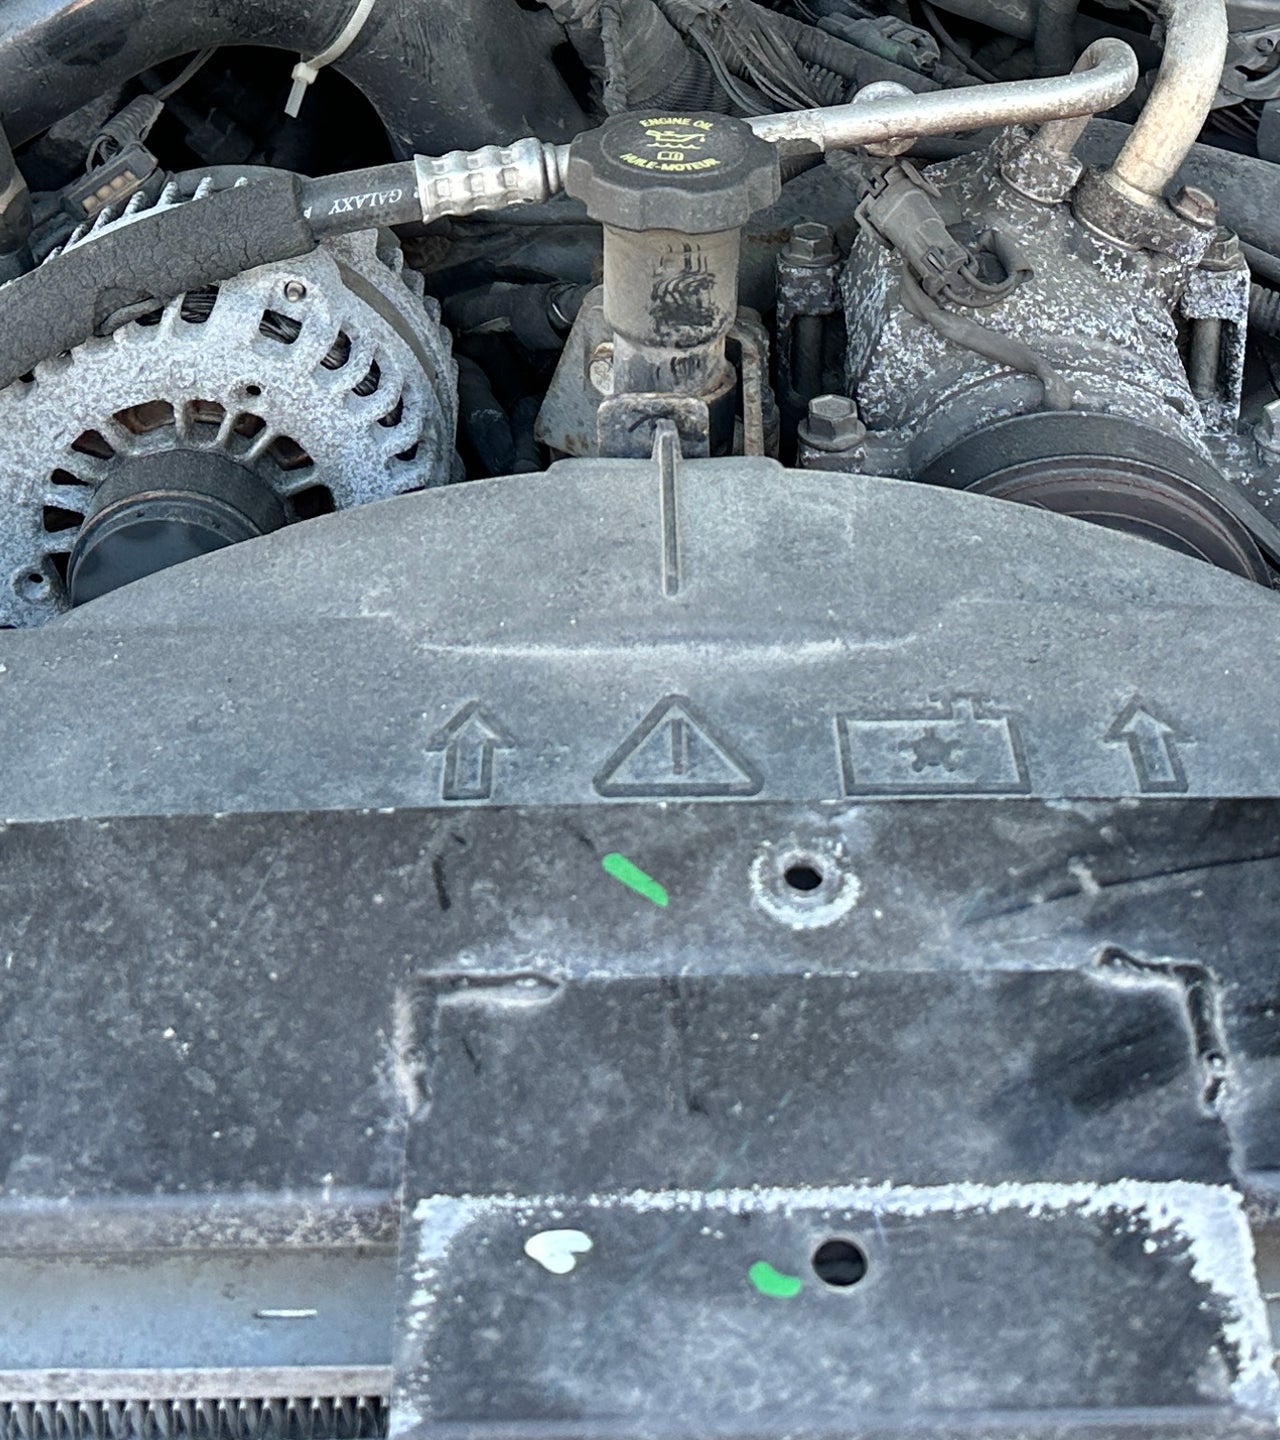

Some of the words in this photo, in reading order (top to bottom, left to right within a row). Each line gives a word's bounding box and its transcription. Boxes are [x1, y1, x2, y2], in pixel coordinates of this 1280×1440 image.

[639, 117, 692, 127] ENGINE
[693, 120, 714, 131] OIL
[620, 153, 721, 172] HUILE-MOTEUR
[328, 188, 403, 216] GALAXY
